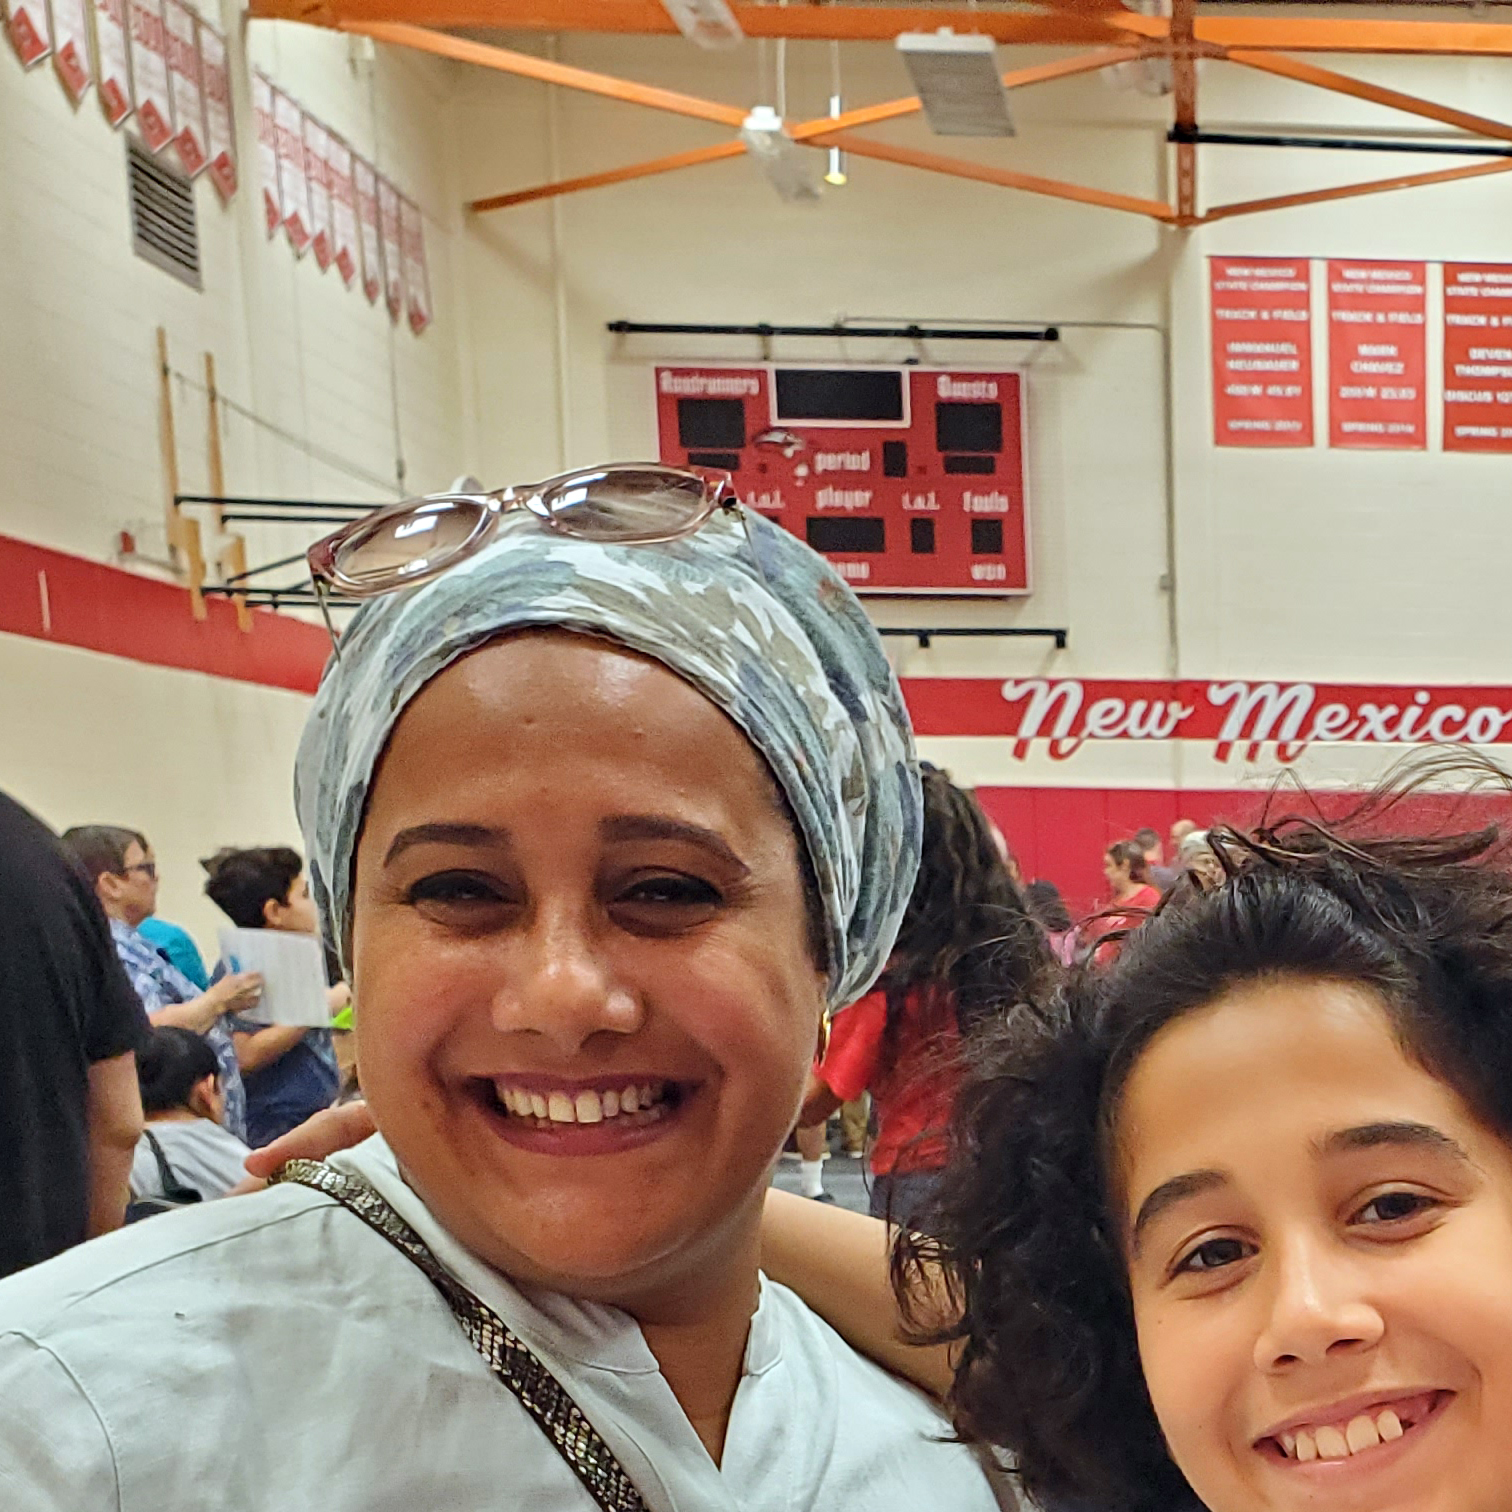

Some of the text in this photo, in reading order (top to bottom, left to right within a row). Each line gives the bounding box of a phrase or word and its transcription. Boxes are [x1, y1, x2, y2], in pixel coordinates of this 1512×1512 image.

[814, 450, 870, 474] period
[815, 485, 873, 511] player
[1002, 679, 1193, 761] New
